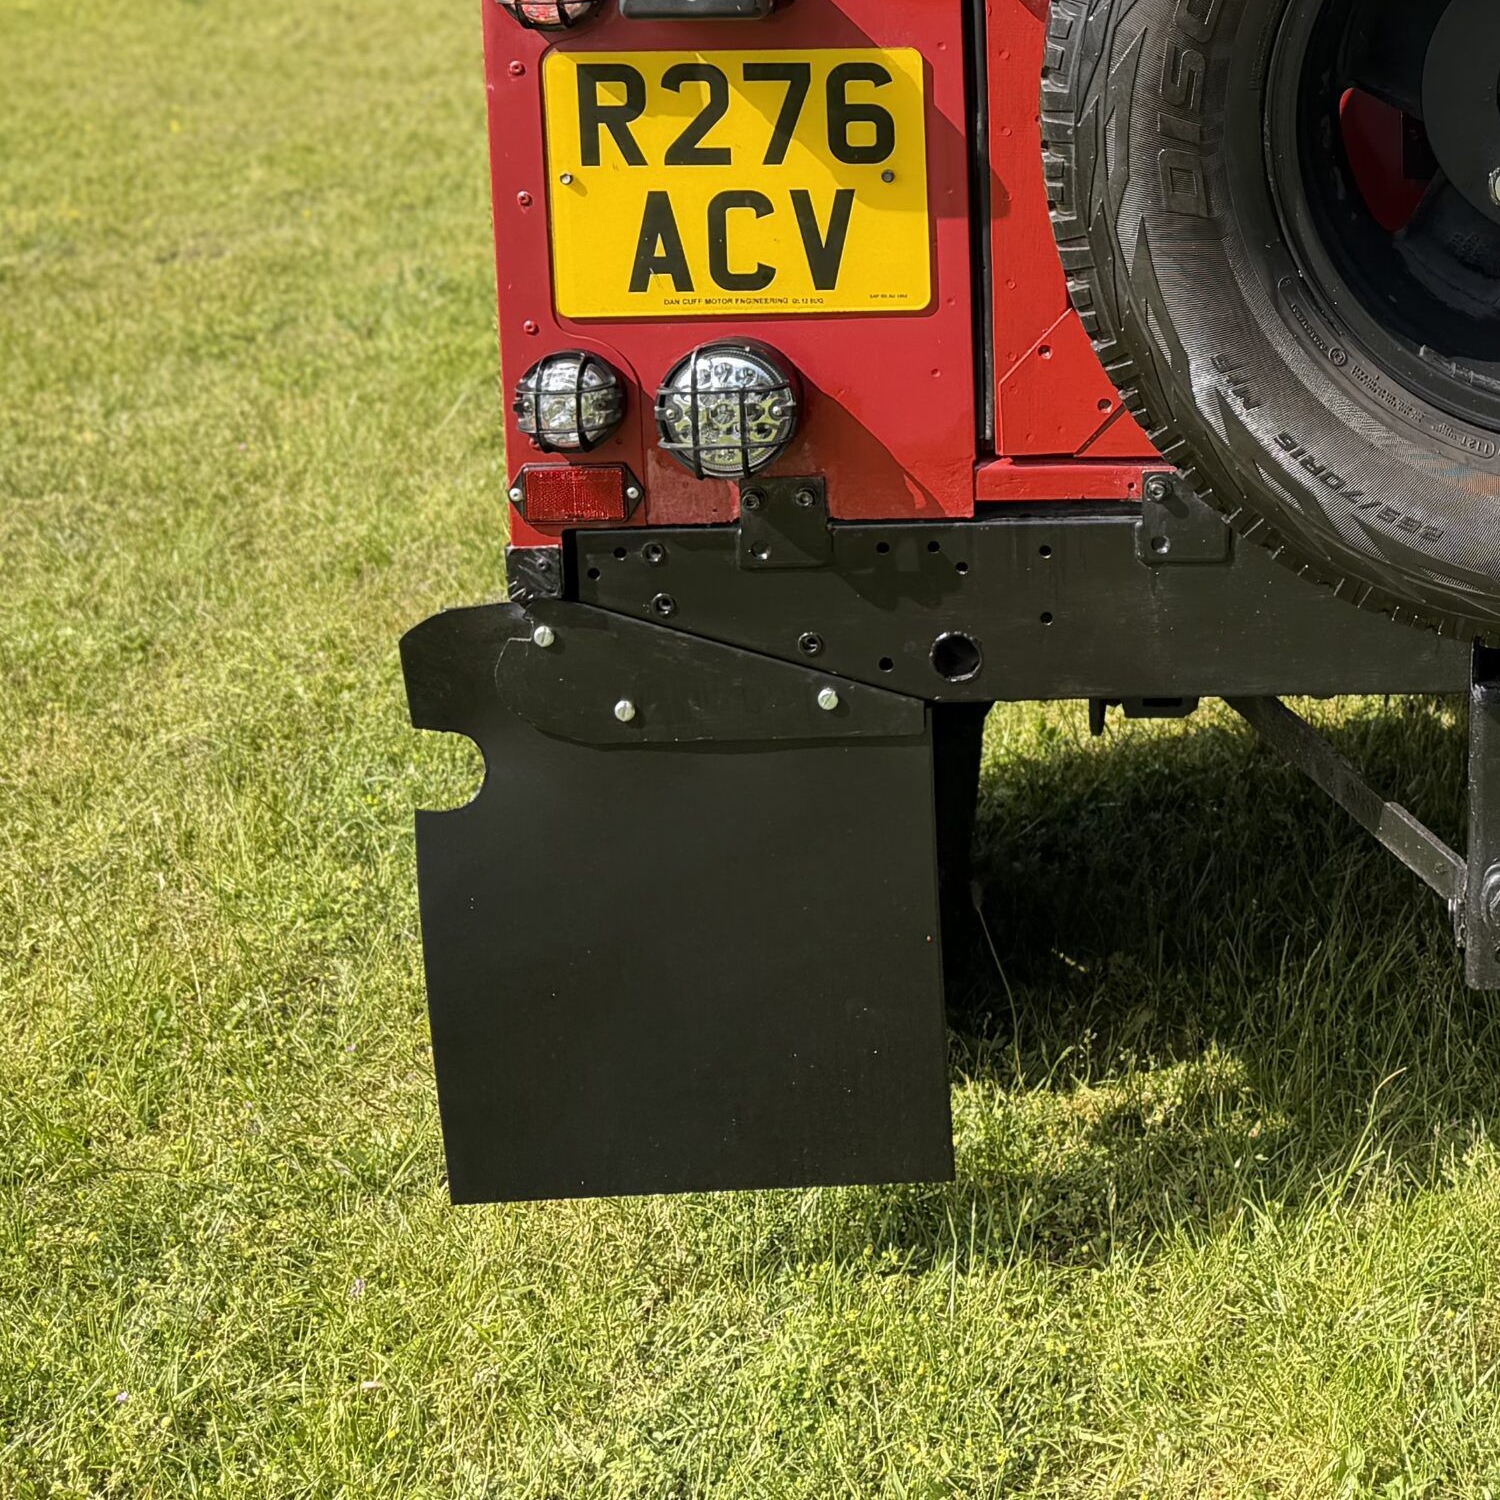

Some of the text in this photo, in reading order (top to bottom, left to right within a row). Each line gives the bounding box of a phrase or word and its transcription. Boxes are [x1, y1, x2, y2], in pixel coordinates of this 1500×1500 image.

[576, 62, 896, 167] R276
[628, 188, 855, 293] ACV
[663, 298, 680, 306] DAN
[682, 298, 702, 306] CUFF
[704, 297, 733, 305] MOTOR
[735, 297, 789, 305] ENGINEERING
